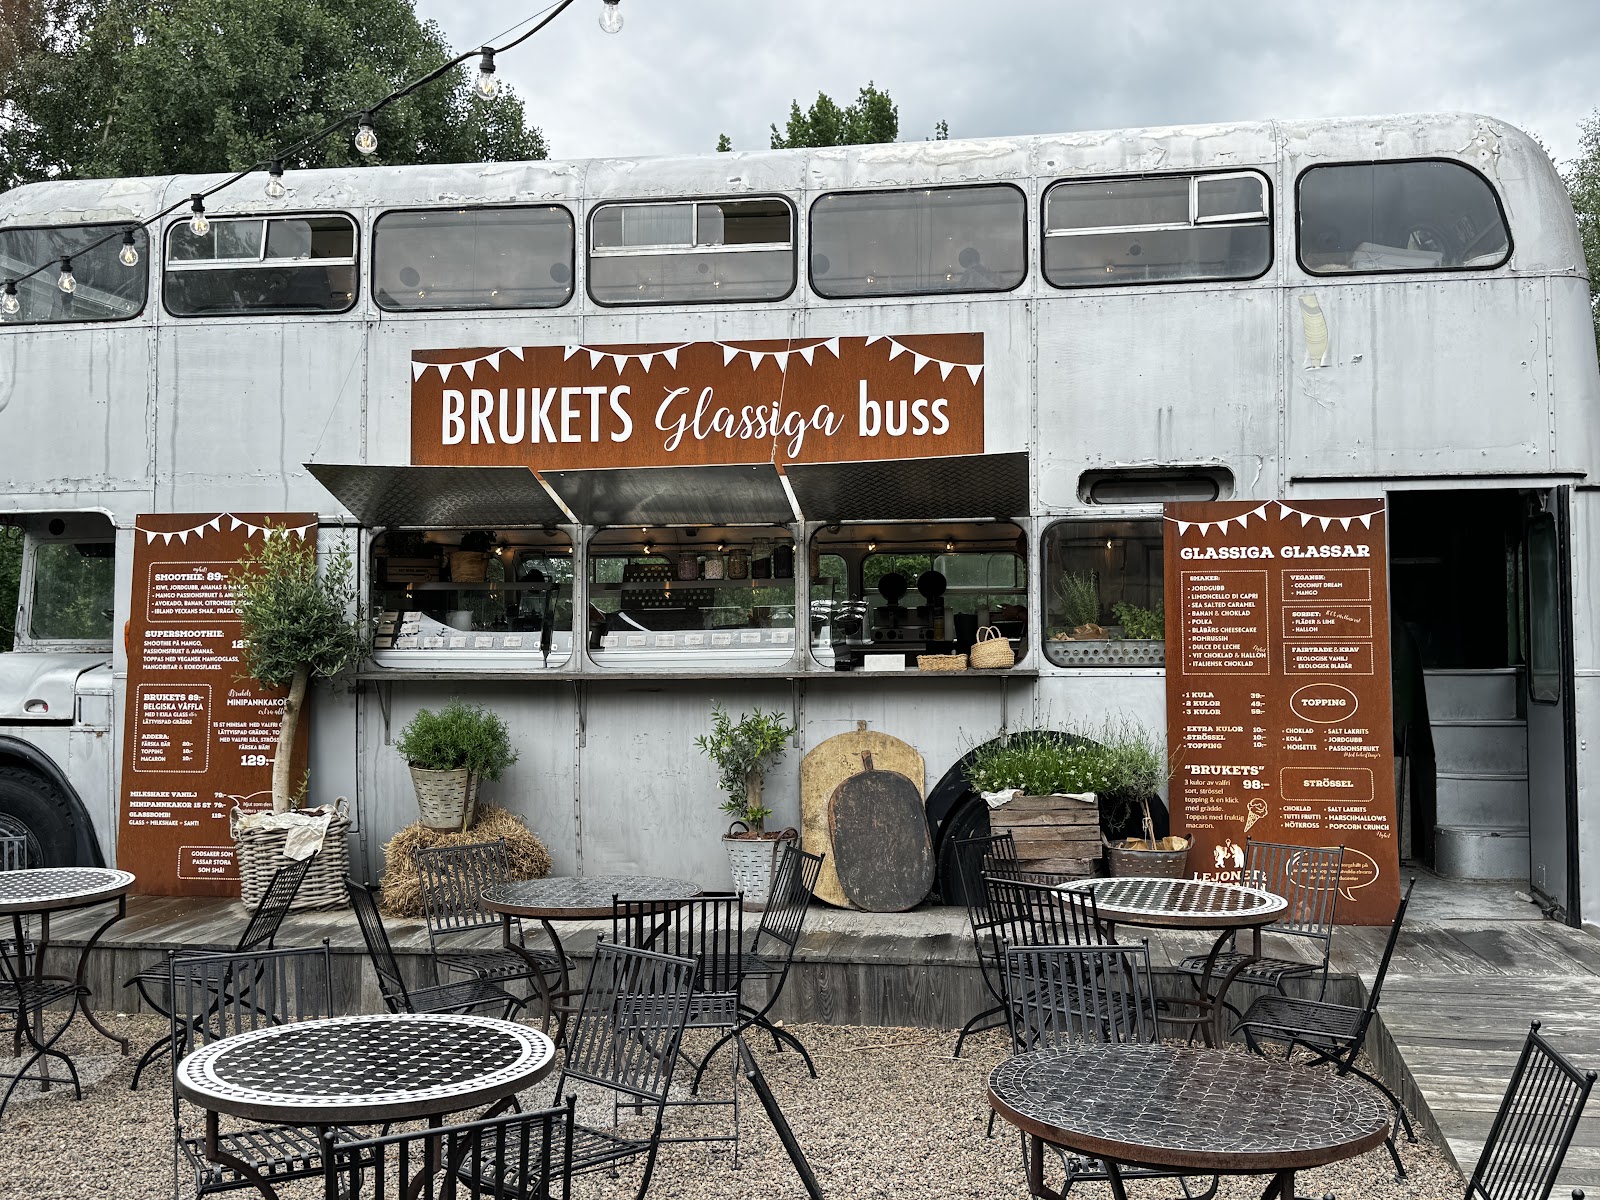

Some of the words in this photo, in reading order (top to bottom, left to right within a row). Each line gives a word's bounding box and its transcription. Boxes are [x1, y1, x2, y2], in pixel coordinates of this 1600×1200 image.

[442, 385, 632, 445] BRUKETS
[655, 386, 844, 459] Glassiga
[859, 380, 949, 437] buss
[1180, 546, 1275, 560] GLASSIGA
[1280, 545, 1370, 558] GLASSAR
[207, 572, 228, 581] 89:-
[241, 755, 274, 766] 129:-
[1243, 779, 1270, 789] 98:-
[1303, 778, 1354, 787] STRÖSSEL
[1224, 814, 1244, 822] fruktig
